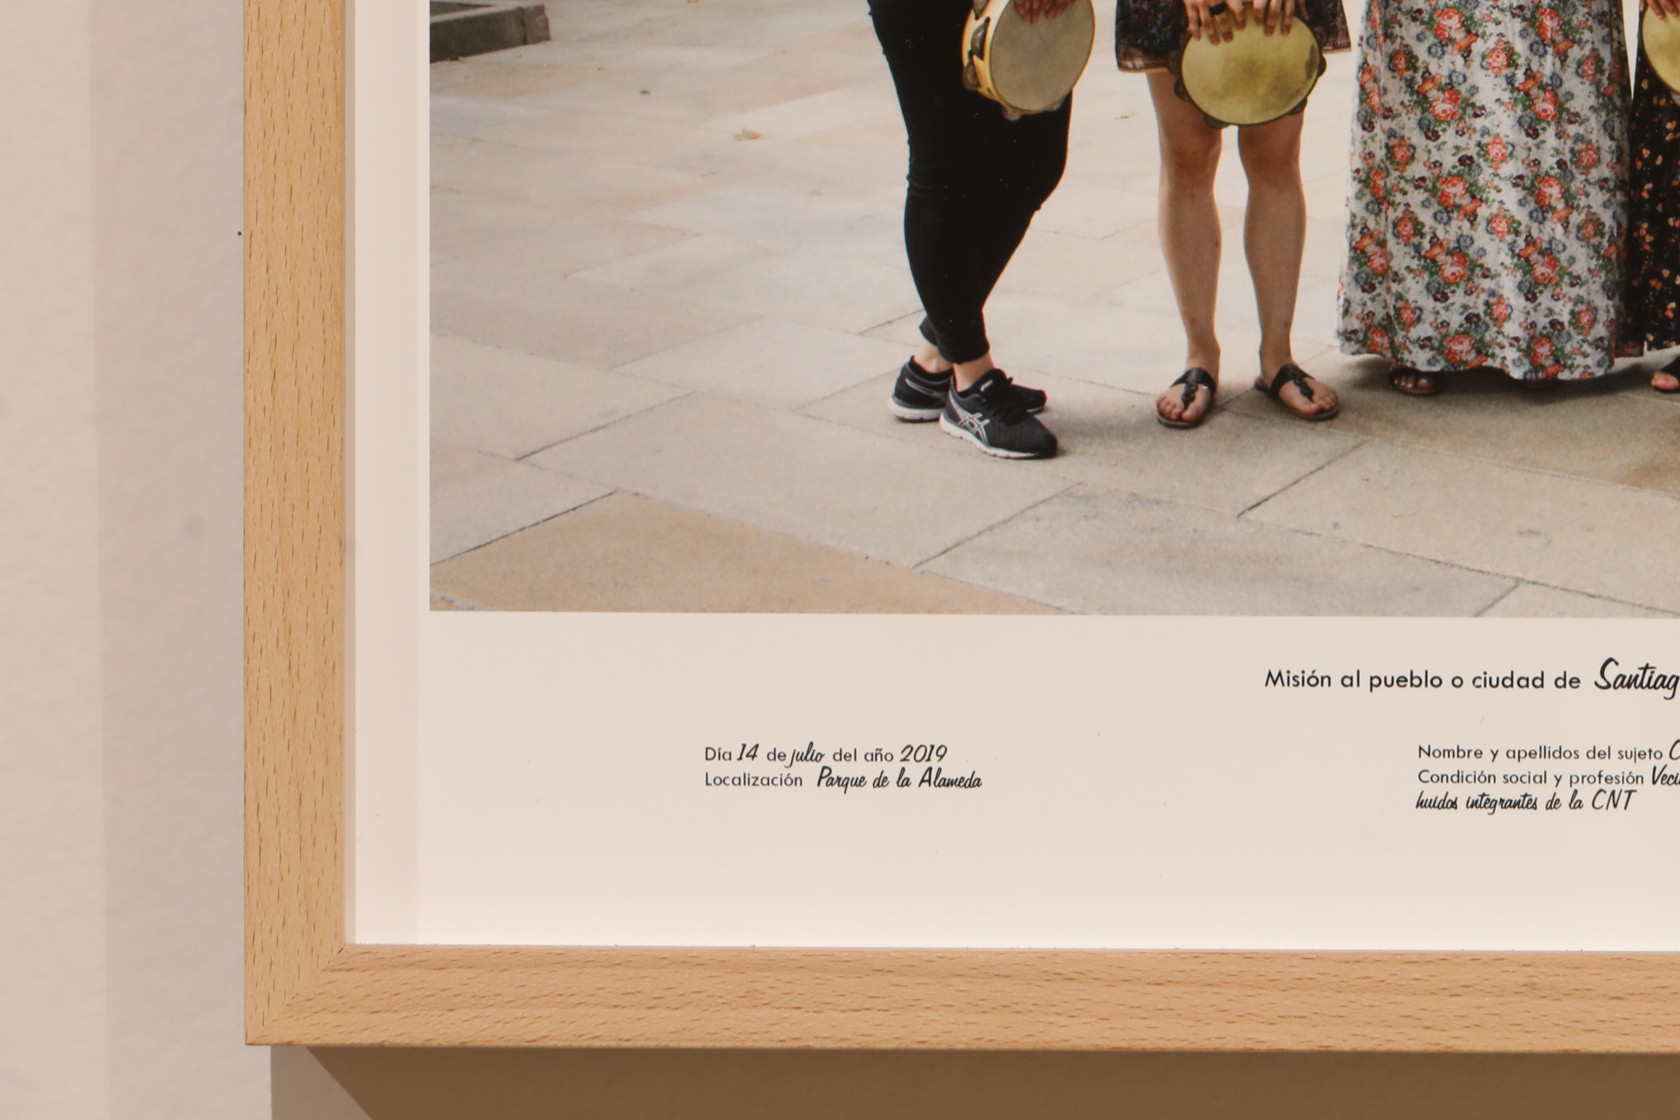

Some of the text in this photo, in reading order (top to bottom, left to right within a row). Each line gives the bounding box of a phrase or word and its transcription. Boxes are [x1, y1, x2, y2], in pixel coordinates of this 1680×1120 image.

[1265, 669, 1331, 687] Misión
[1341, 669, 1360, 688] al
[1370, 669, 1443, 693] pueblo
[1451, 676, 1464, 688] o
[1472, 670, 1544, 689] ciudad
[1554, 670, 1581, 689] de
[705, 741, 947, 768] Día 14 de julio del año 2019
[1419, 744, 1483, 759] Nombre
[1490, 749, 1499, 763] y
[1506, 745, 1579, 763] apellidos
[1586, 745, 1611, 759] del
[1618, 747, 1663, 763] sujeto
[706, 765, 982, 794] Localización Parque de la Alameda
[1418, 769, 1496, 784] Condición
[1503, 770, 1547, 784] social
[1554, 775, 1562, 788] y
[1570, 770, 1644, 788] profesión
[1416, 788, 1637, 815] huidos integrantes de la CNT
